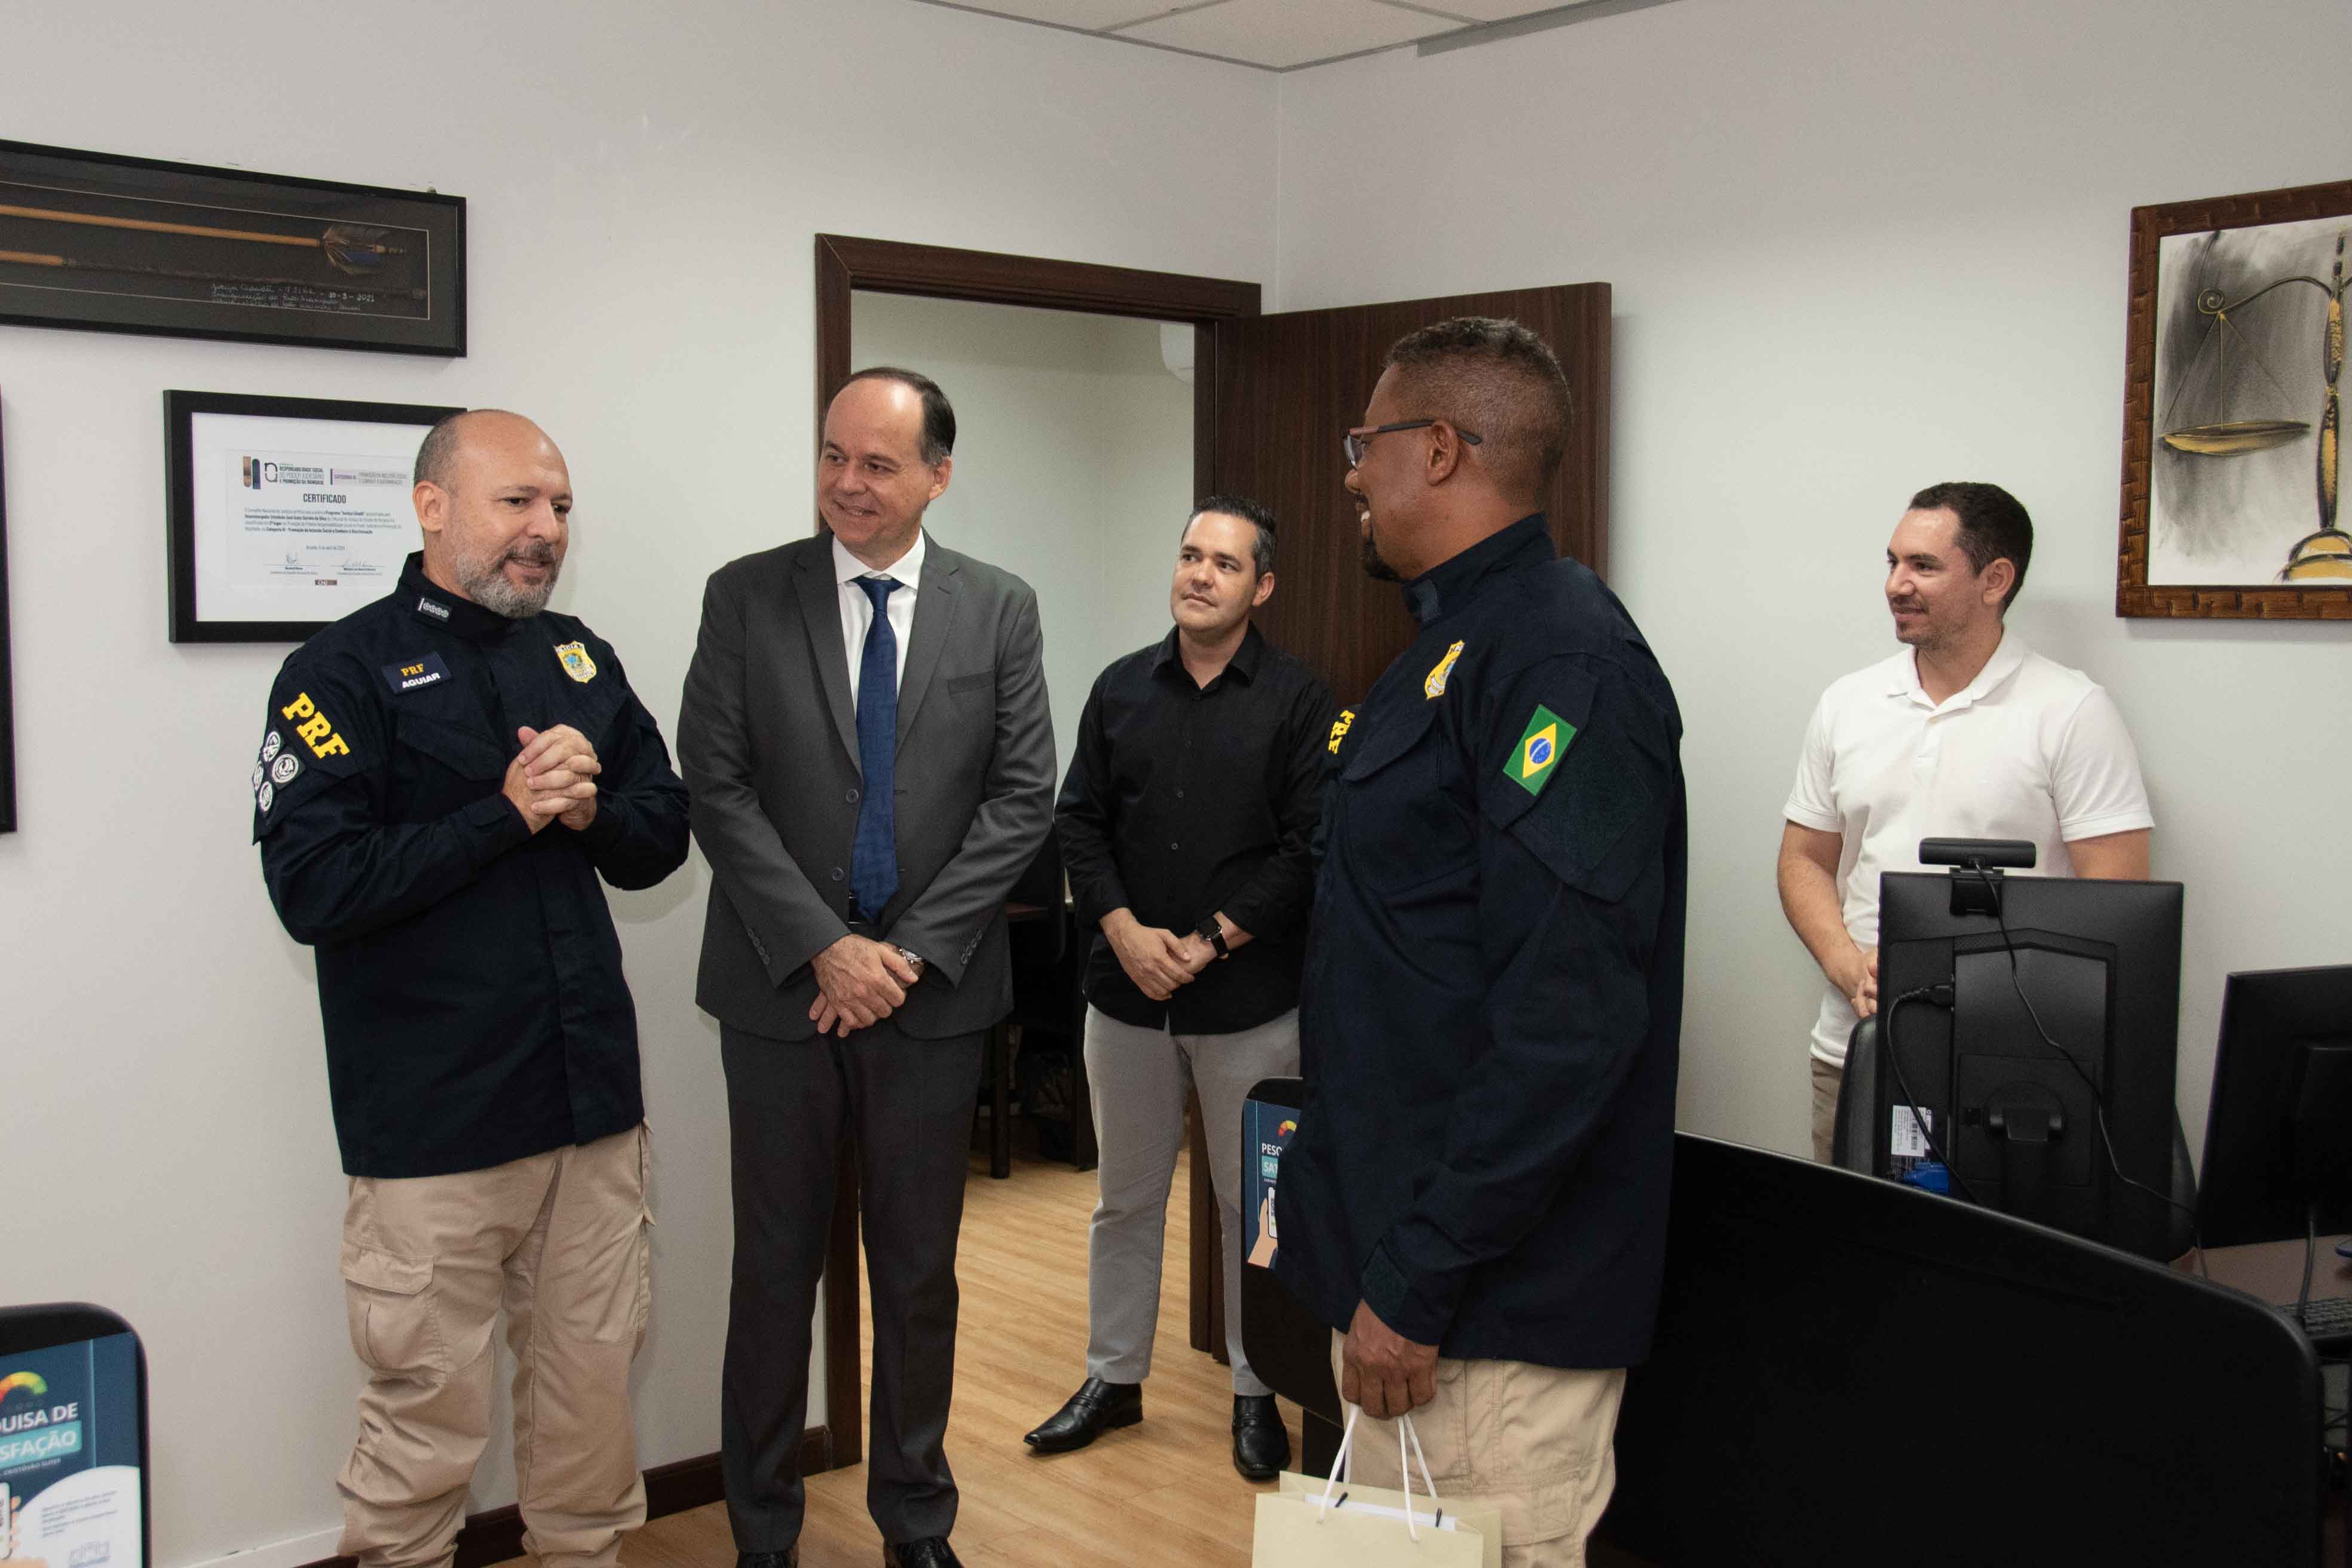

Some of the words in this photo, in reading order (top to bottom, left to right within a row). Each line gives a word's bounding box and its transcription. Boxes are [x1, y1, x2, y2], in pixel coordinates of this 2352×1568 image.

[303, 493, 347, 504] CERTIFICADO
[401, 663, 425, 677] PRF
[402, 672, 440, 688] AGUIAR
[282, 692, 350, 760] PRF
[0, 1409, 48, 1432] UISA
[51, 1402, 79, 1422] DE
